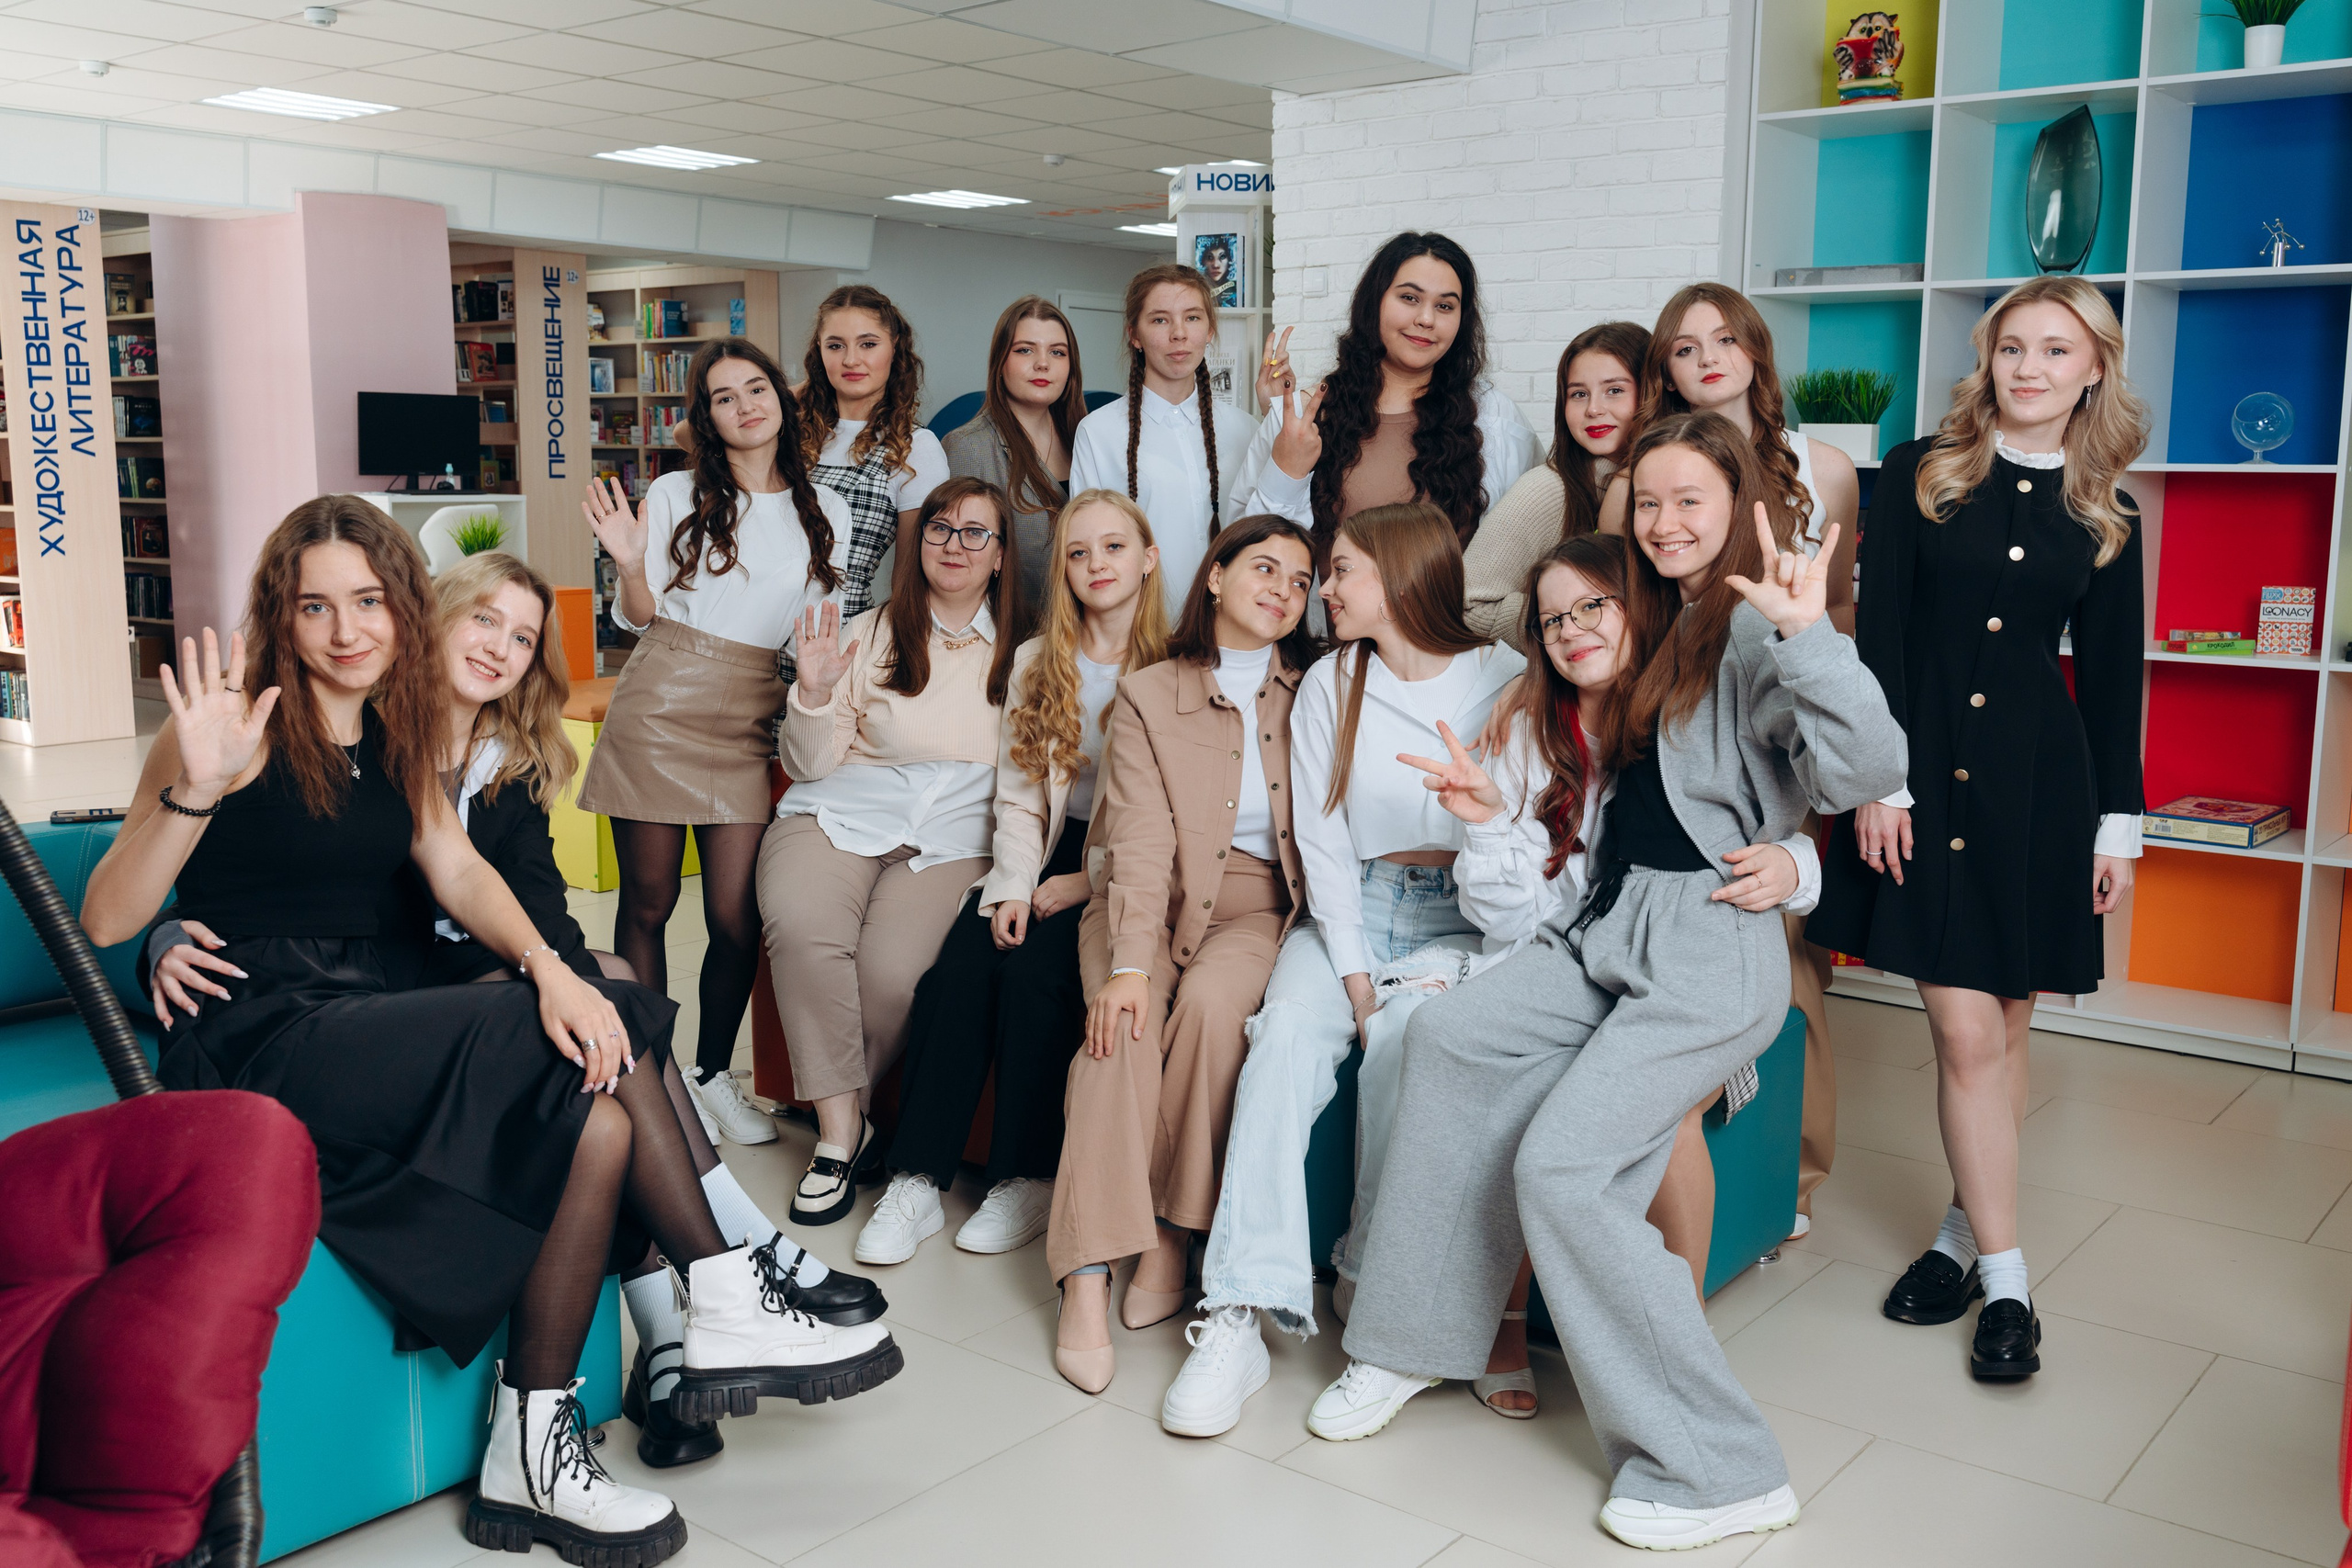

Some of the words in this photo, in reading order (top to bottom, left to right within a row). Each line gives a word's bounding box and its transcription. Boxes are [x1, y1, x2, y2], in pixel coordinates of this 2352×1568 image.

[78, 209, 95, 222] 12+
[566, 270, 579, 282] 12+
[16, 219, 66, 558] ХУДОЖЕСТВЕННАЯ
[55, 224, 96, 457] ЛИТЕРАТУРА
[542, 265, 566, 479] ПРОСВЕЩЕНИЕ
[2262, 606, 2312, 617] LOONACY
